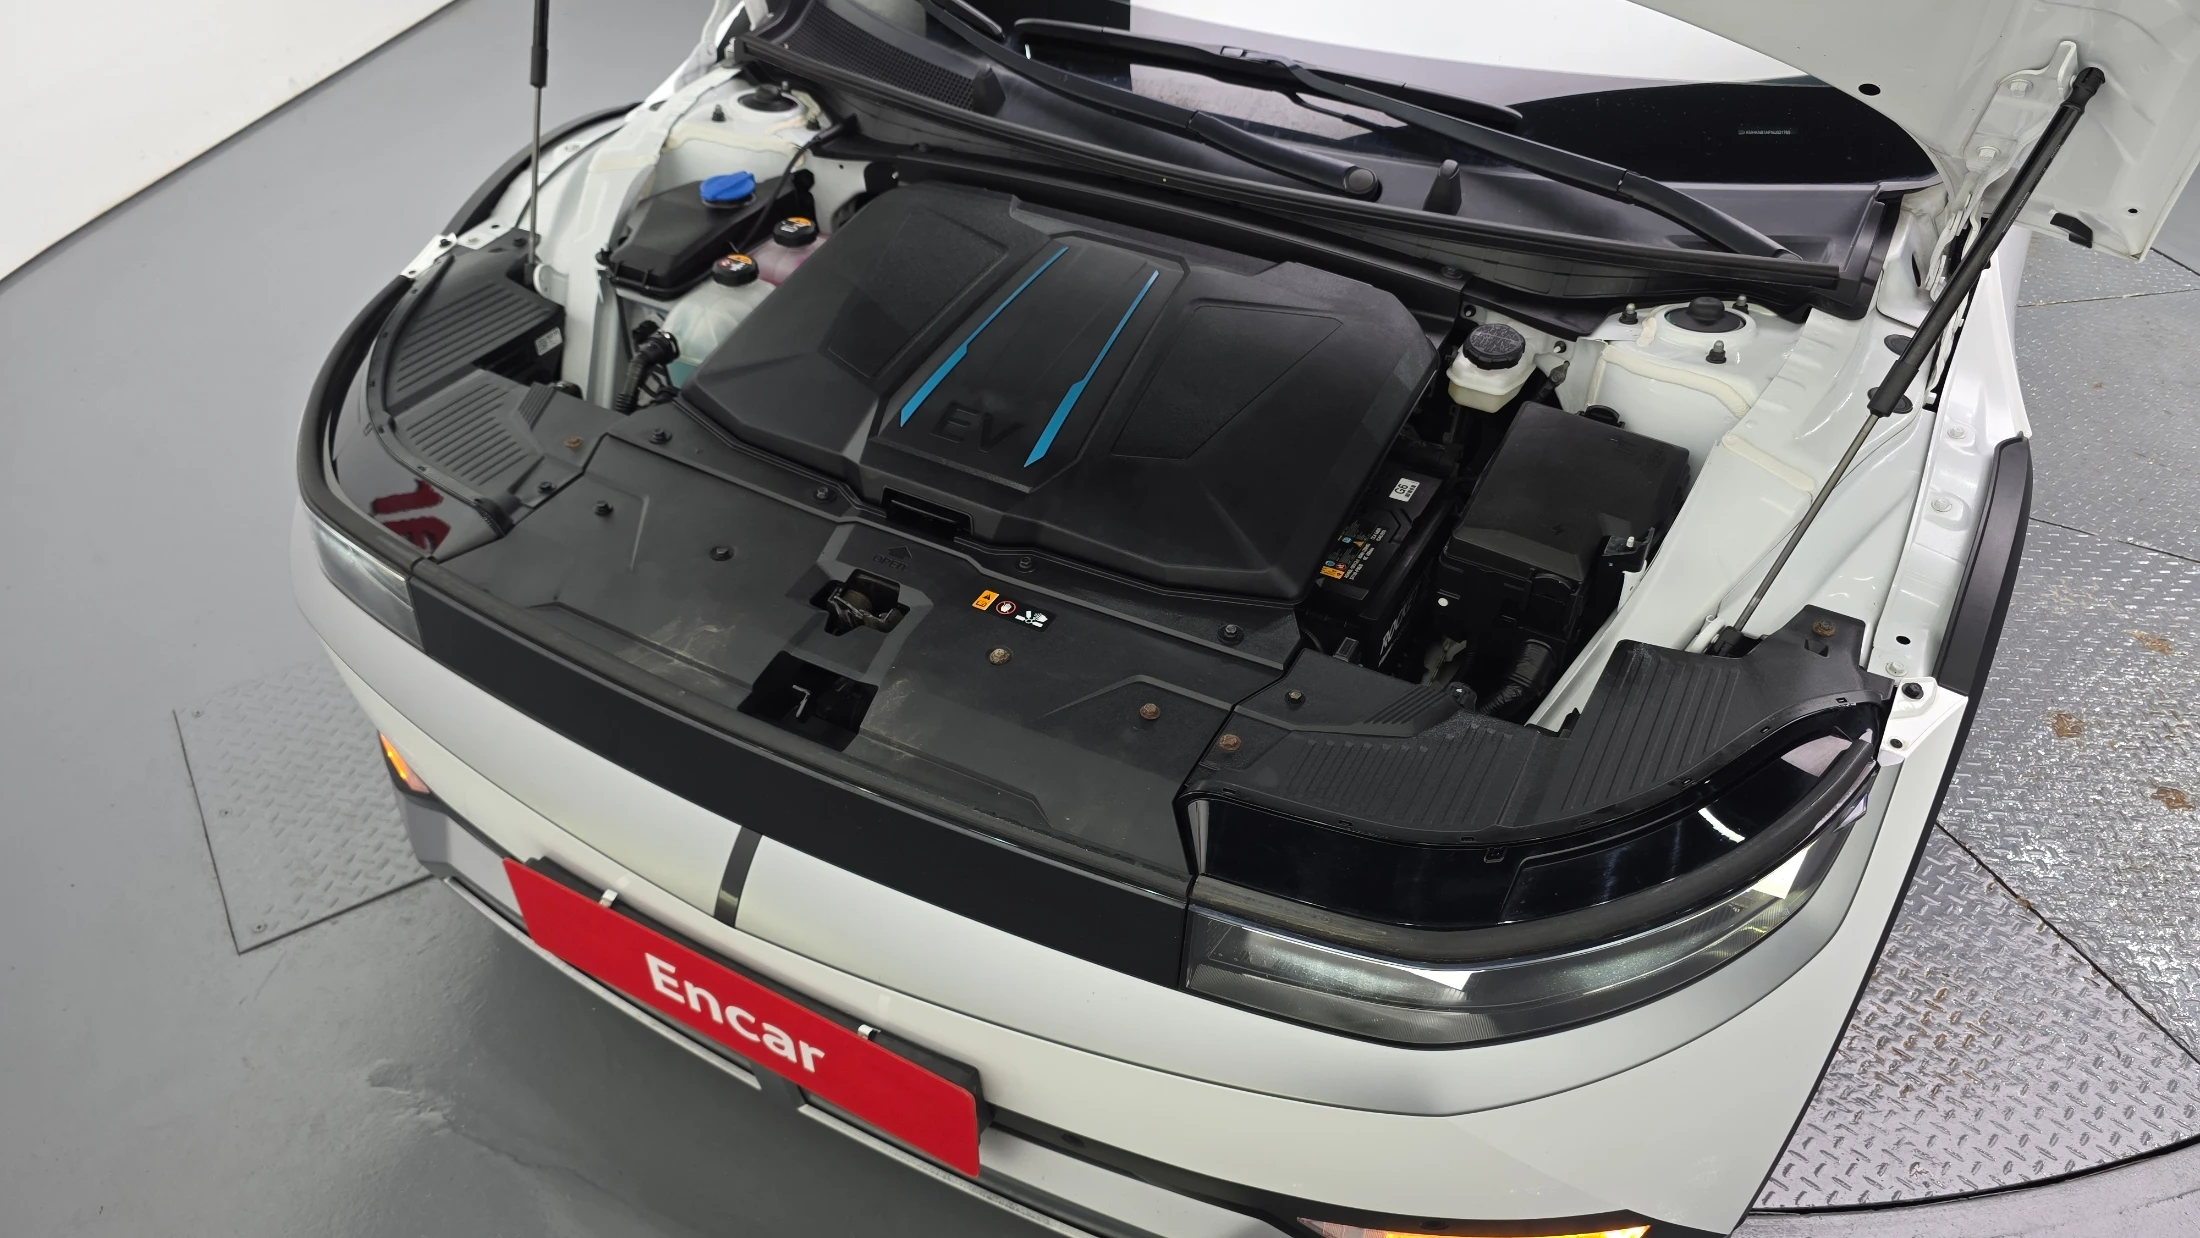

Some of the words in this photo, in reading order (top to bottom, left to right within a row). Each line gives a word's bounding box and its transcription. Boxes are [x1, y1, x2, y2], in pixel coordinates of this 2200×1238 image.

[929, 402, 1024, 453] EV
[872, 553, 908, 572] OPEN
[644, 952, 825, 1073] Encar
